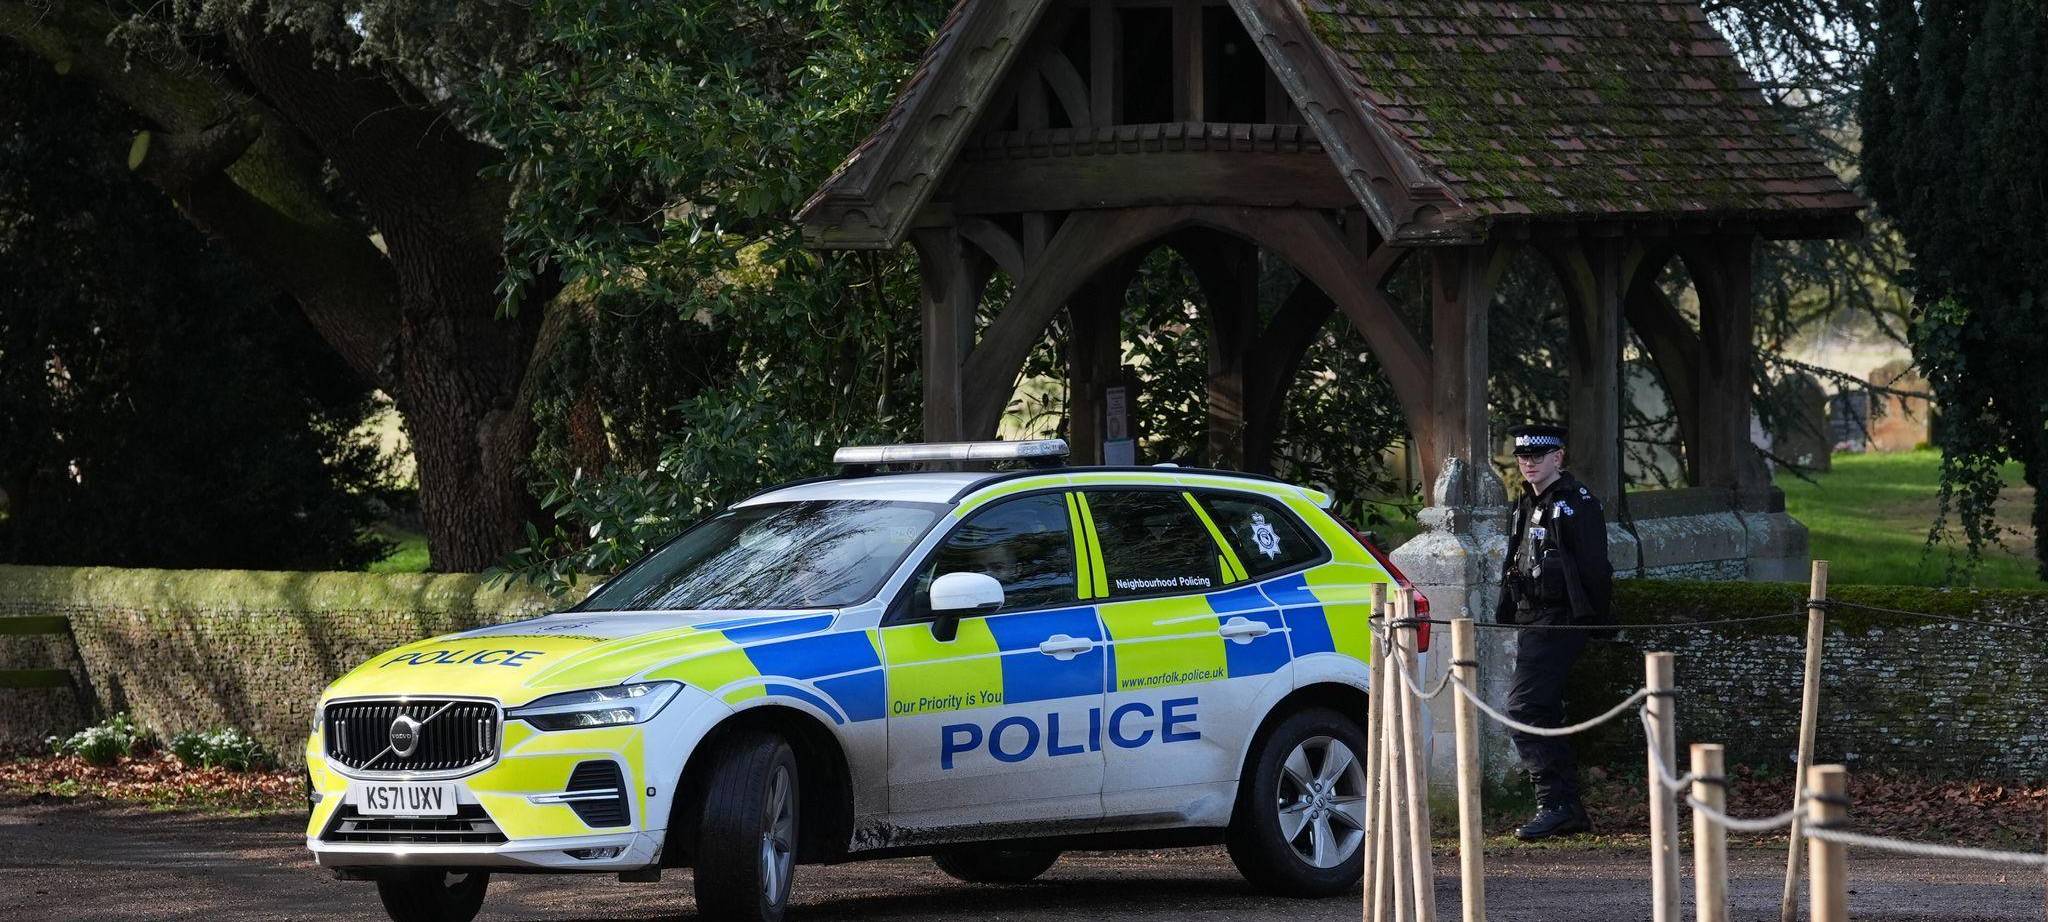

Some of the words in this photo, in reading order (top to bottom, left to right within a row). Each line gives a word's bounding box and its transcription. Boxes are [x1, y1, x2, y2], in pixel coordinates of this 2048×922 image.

[1116, 577, 1177, 590] Neighbourhood
[1179, 576, 1211, 587] Policing
[380, 649, 546, 669] POLICE
[1121, 667, 1224, 688] www.norfolk.police.uk
[893, 699, 915, 714] Our
[919, 694, 962, 711] Priority
[965, 691, 976, 705] is
[980, 689, 1002, 704] You
[940, 696, 1201, 770] POLICE
[366, 786, 405, 810] KS71
[409, 787, 442, 810] UXV
